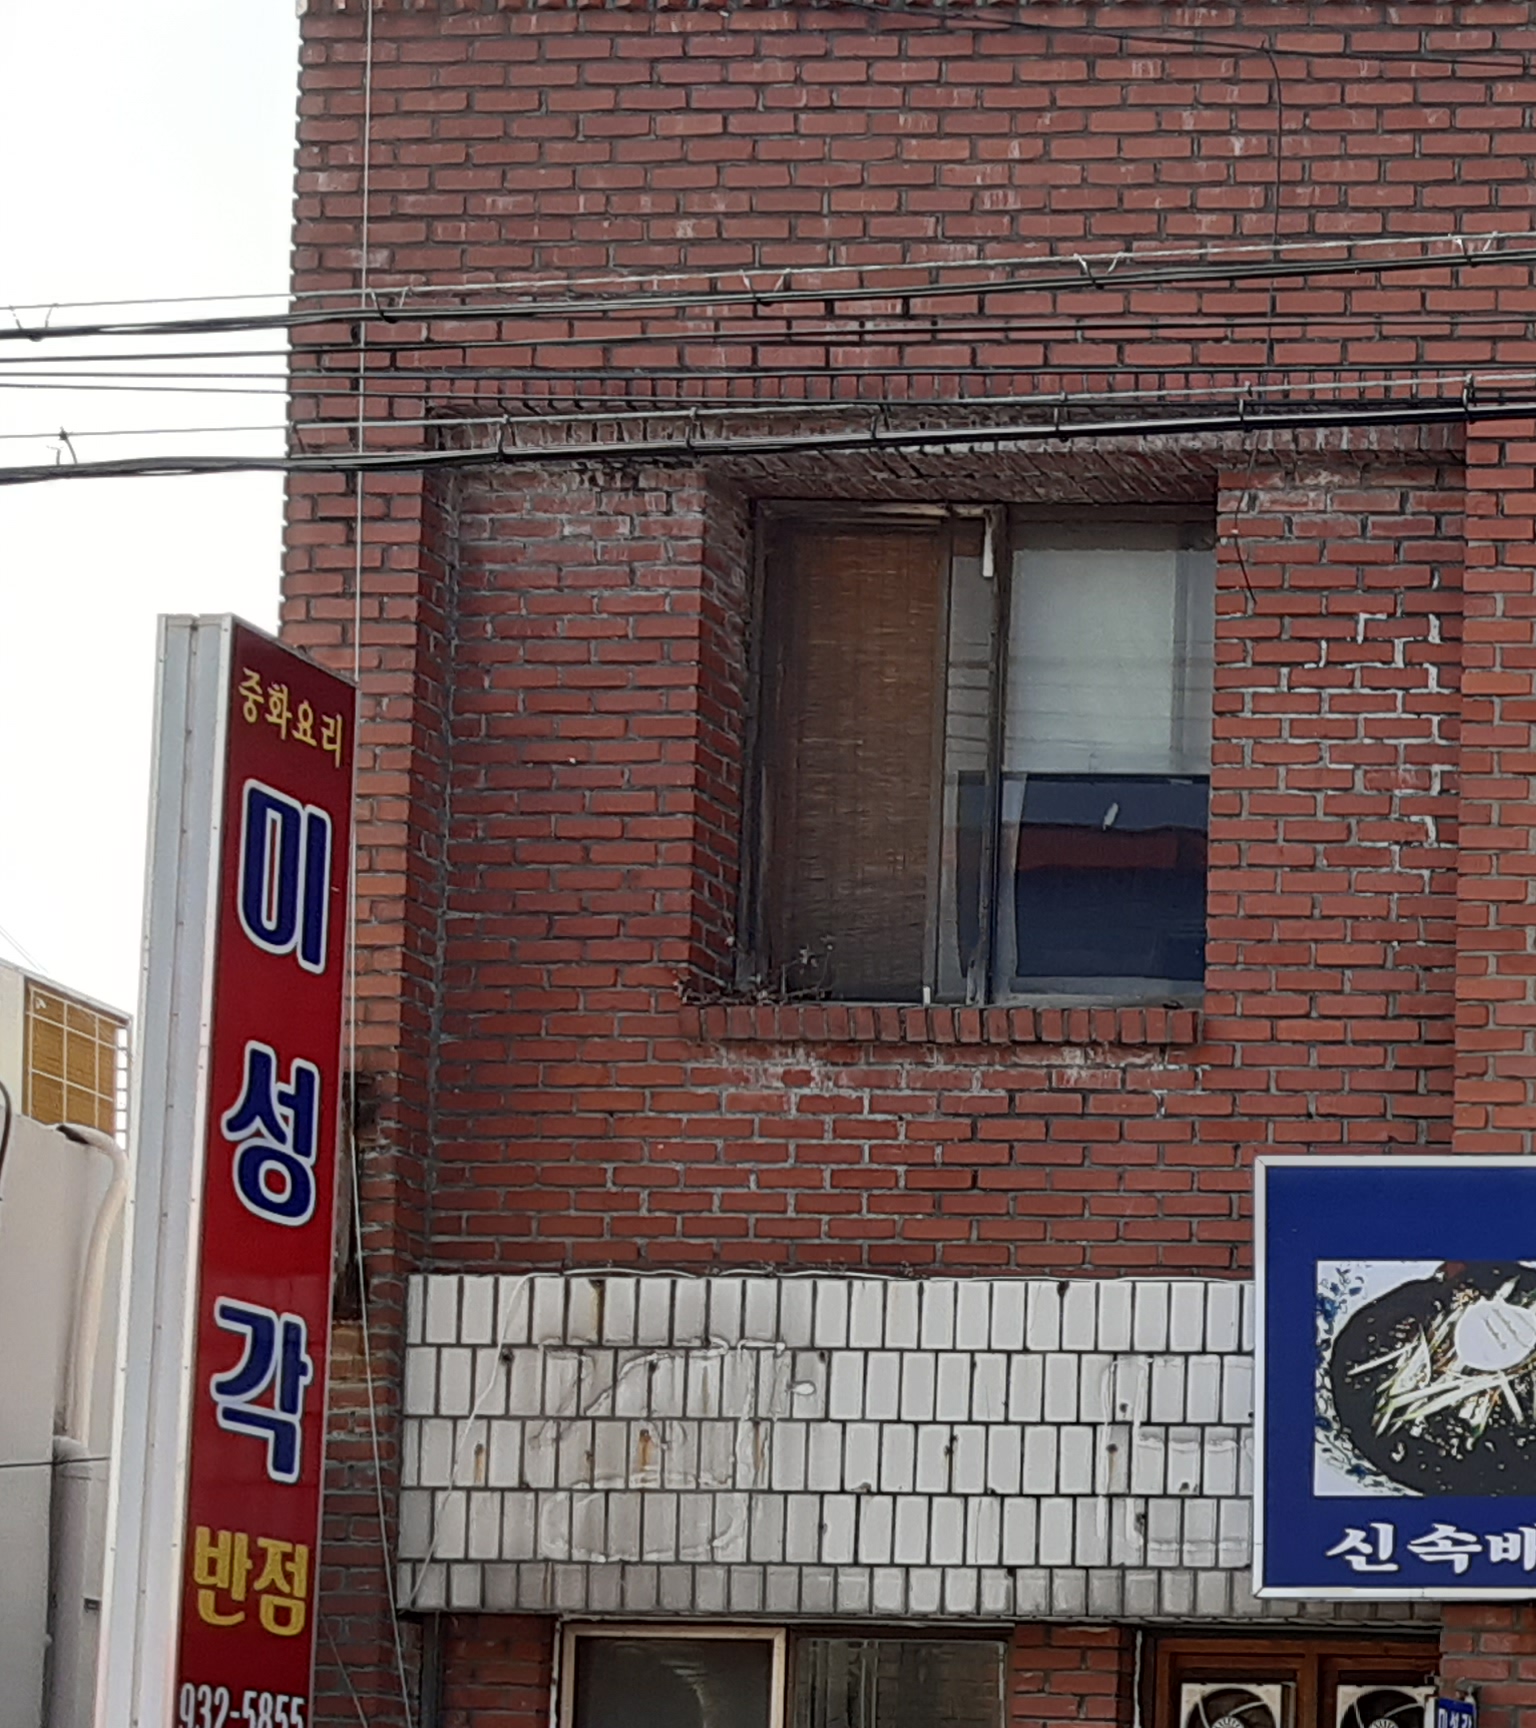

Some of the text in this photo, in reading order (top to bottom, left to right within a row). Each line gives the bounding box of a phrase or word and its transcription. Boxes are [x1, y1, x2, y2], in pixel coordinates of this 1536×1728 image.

[239, 667, 344, 768] 중화요리
[210, 778, 332, 1484] 미성각
[194, 1526, 309, 1636] 반점
